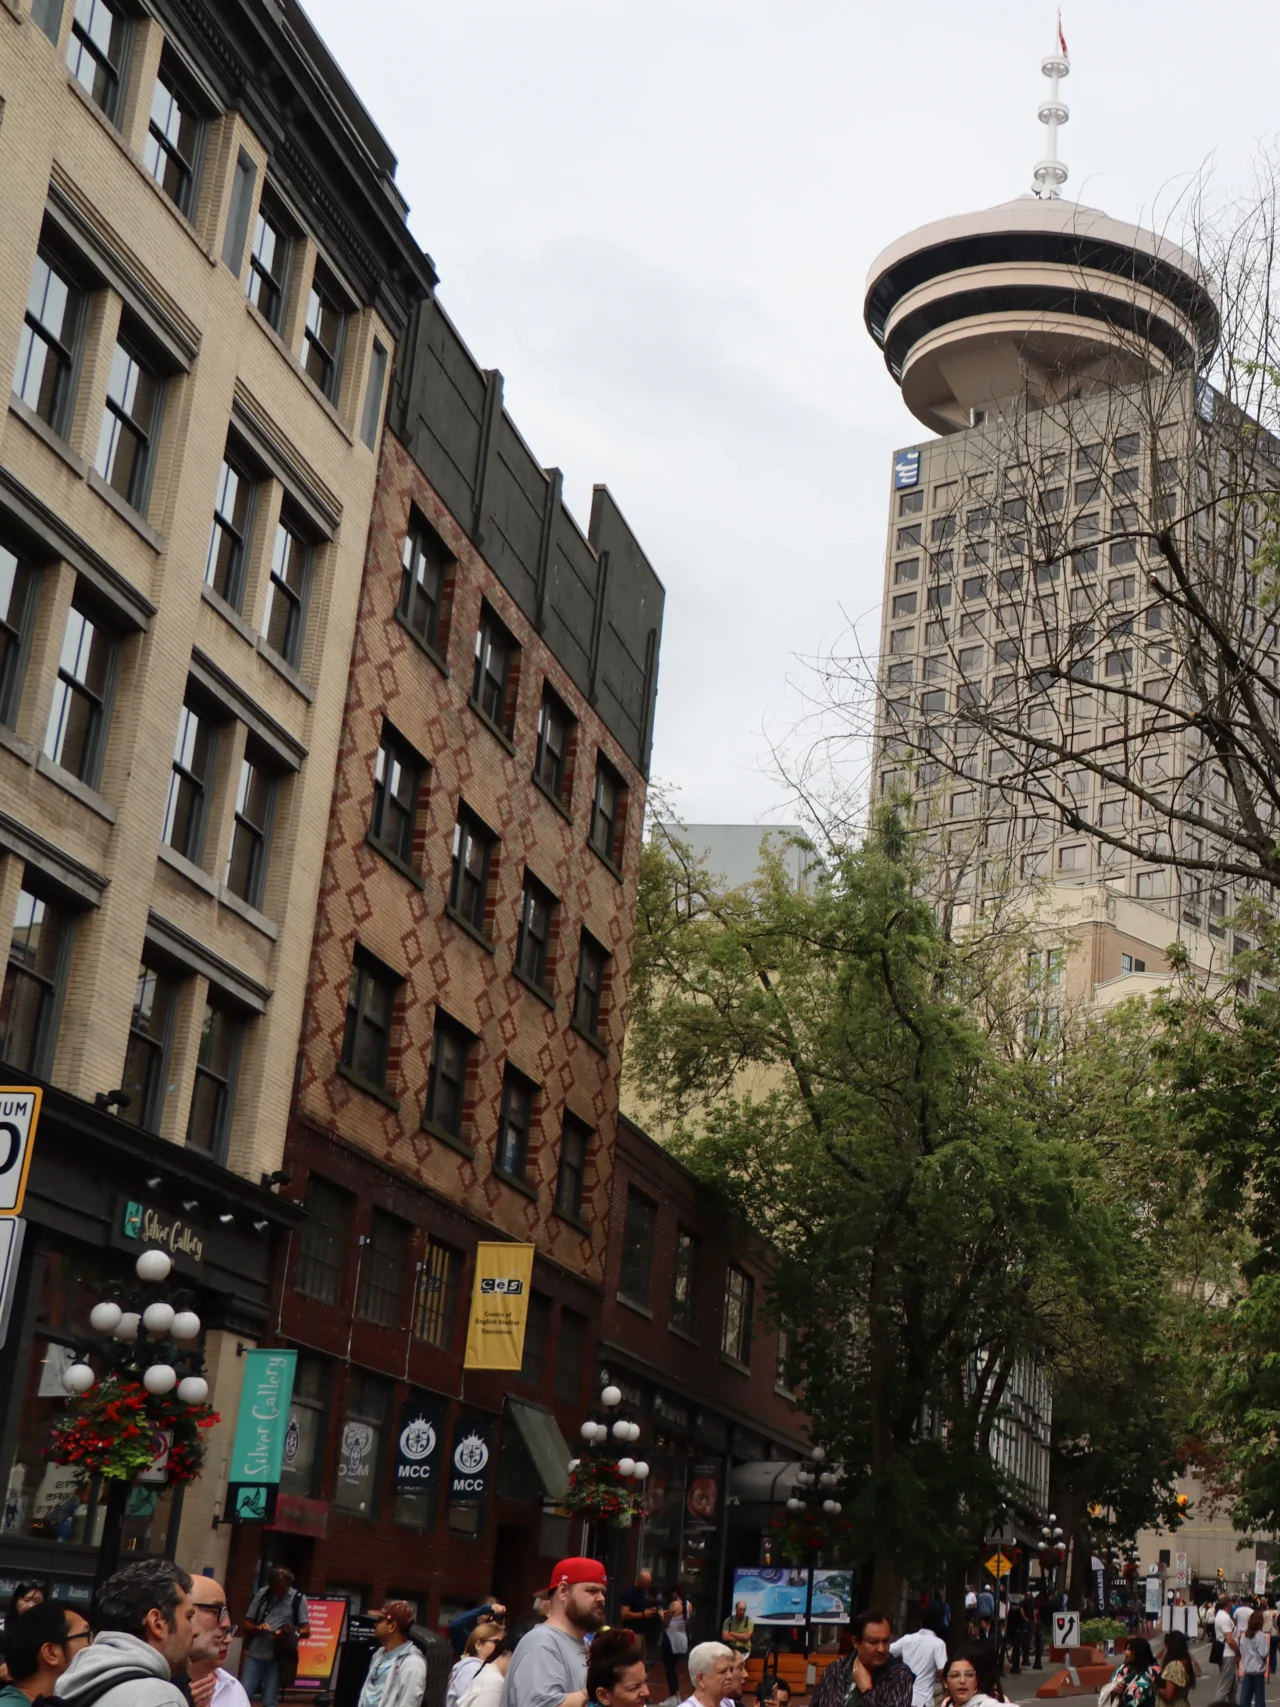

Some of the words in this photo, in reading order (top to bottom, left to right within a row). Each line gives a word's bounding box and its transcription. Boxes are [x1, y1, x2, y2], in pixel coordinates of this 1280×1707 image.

[142, 1208, 170, 1243] Silver
[168, 1221, 204, 1262] Gallery
[252, 1356, 287, 1421] Gallery
[243, 1424, 271, 1476] Silver
[398, 1465, 430, 1478] MCC
[453, 1479, 484, 1491] MCC
[68, 1585, 89, 1598] Ramen
[1097, 1570, 1105, 1611] CANNABIS
